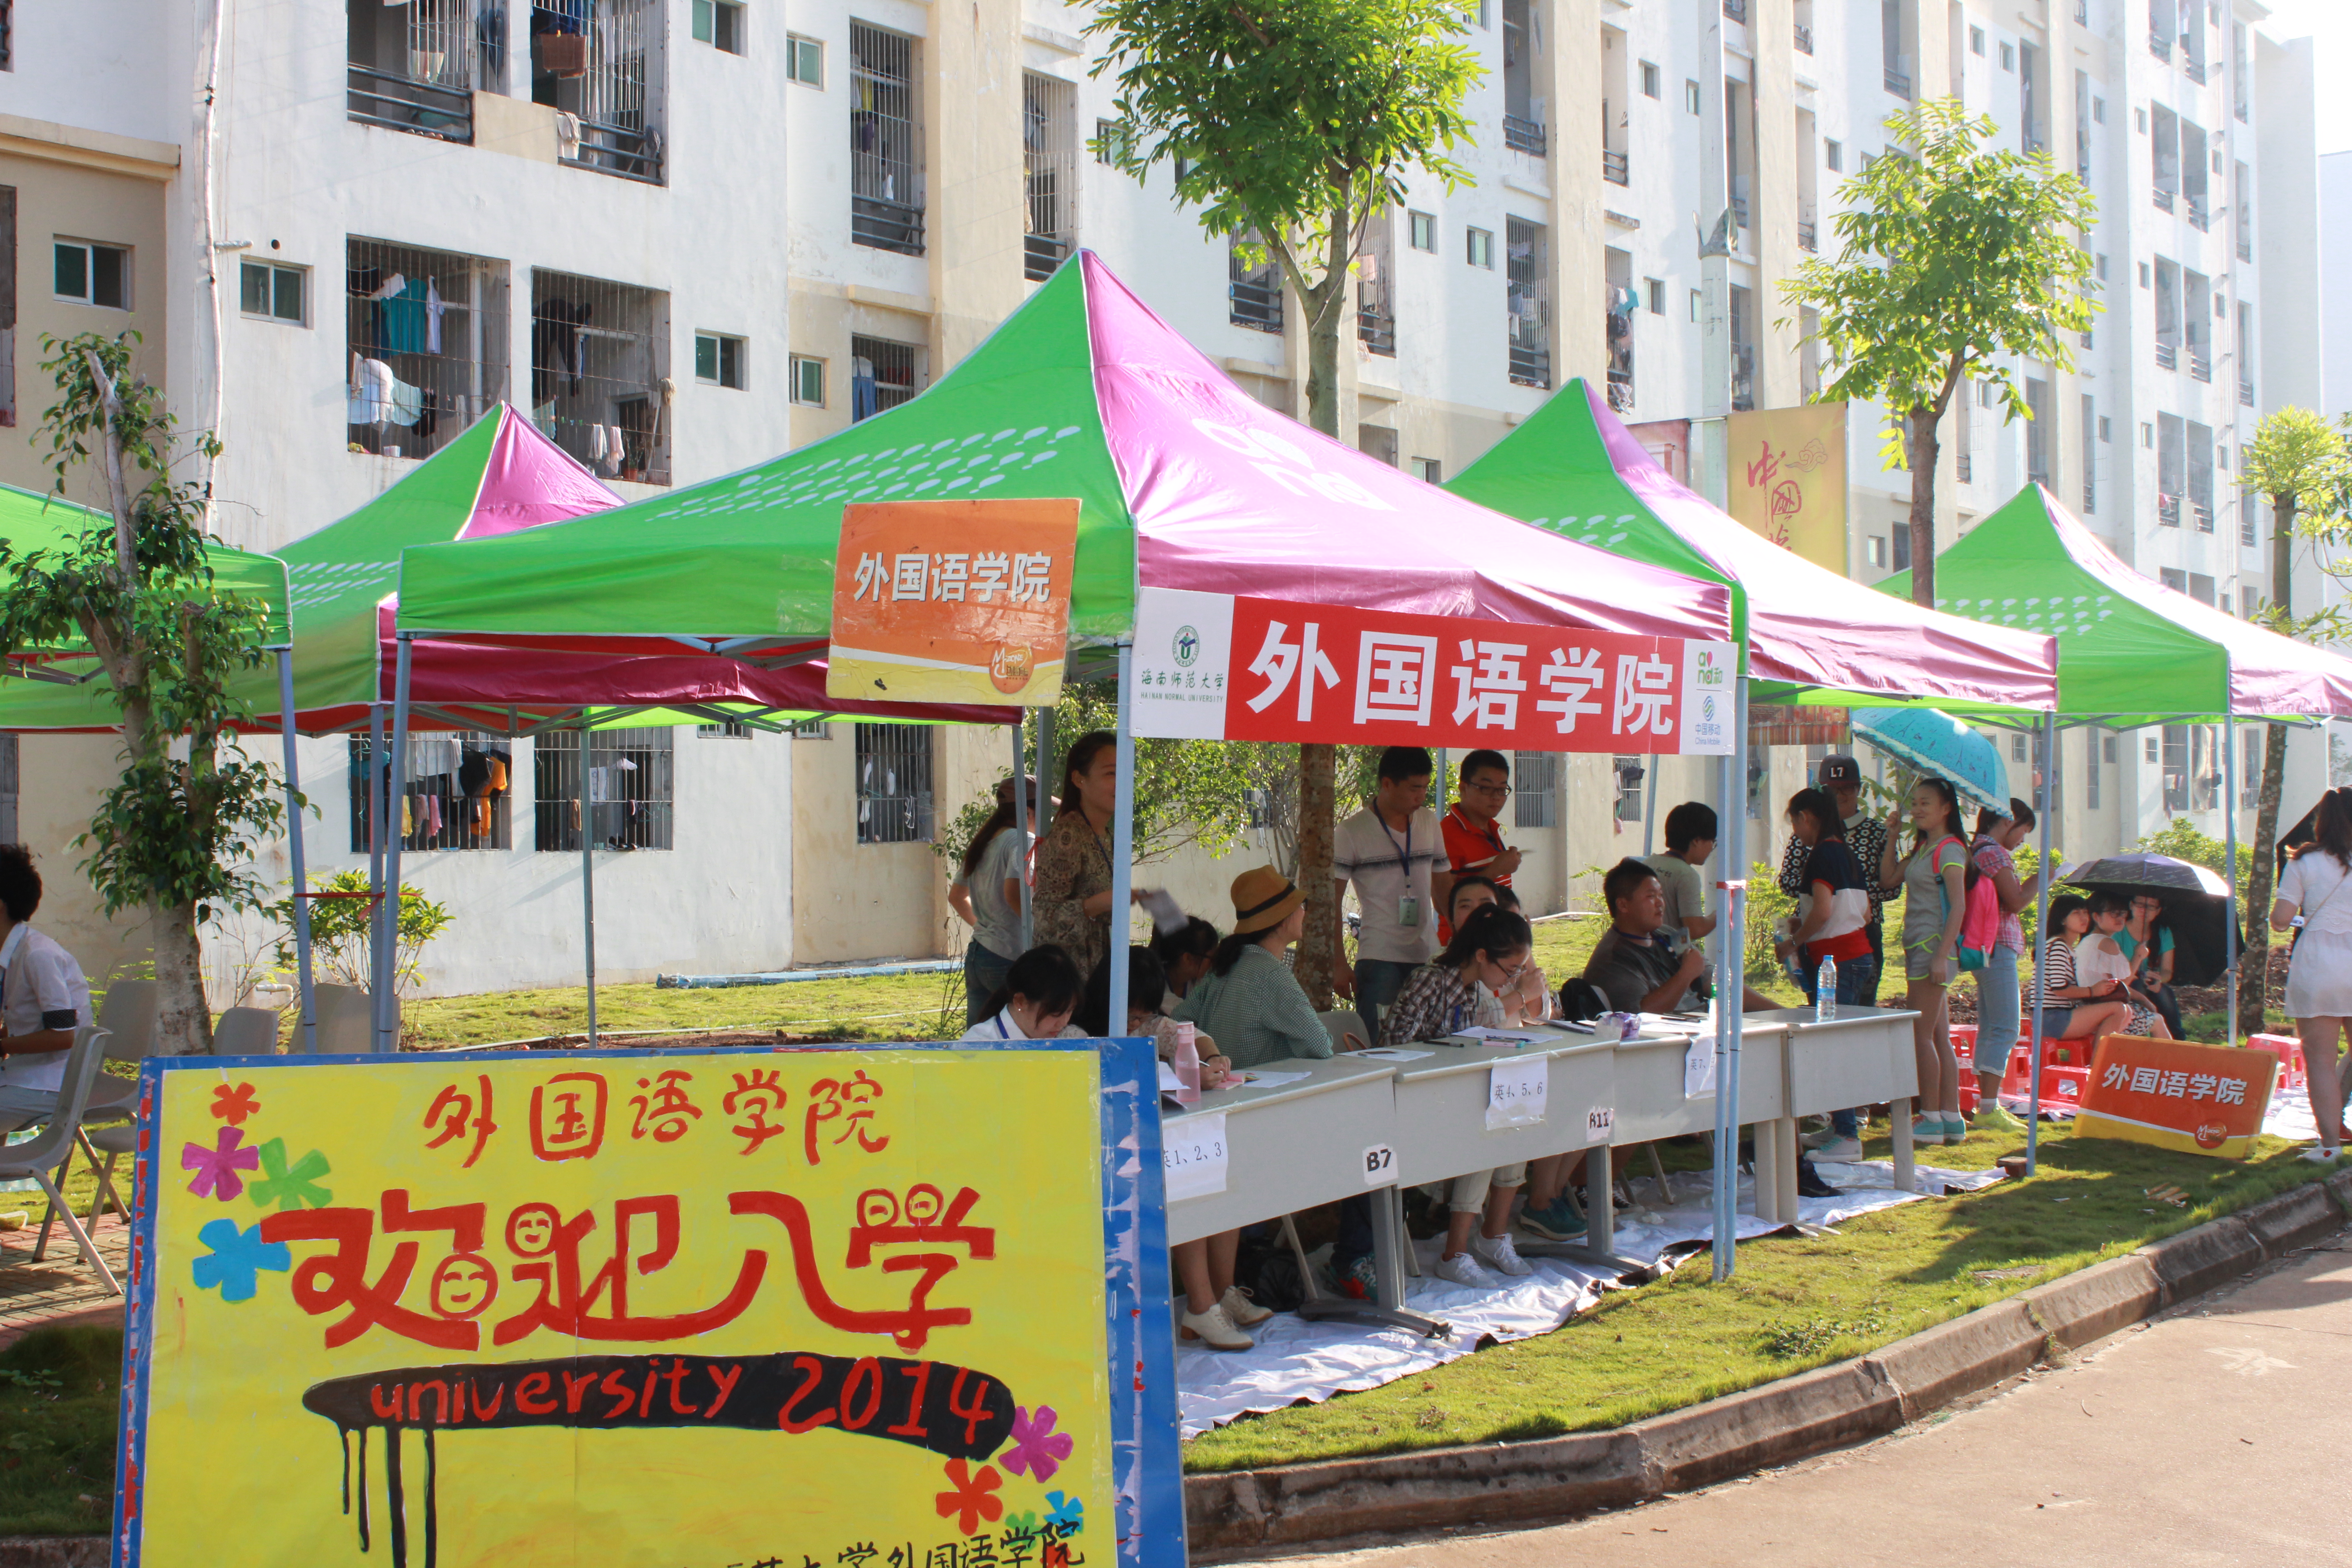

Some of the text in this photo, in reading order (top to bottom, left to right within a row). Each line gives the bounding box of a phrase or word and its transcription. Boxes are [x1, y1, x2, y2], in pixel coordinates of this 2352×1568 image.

[853, 551, 1051, 603] 外国语学院
[1142, 669, 1223, 691] 海南师范大学
[1246, 620, 1675, 735] 外国语学院
[1141, 691, 1224, 703] HAINAN NORMAL UNIVERSITY
[1695, 722, 1721, 736] 中国移动
[1695, 737, 1707, 745] China
[1830, 766, 1844, 778] L7
[2102, 1063, 2248, 1106] 外国语学院
[423, 1069, 890, 1168] 外国语学院
[1366, 1148, 1392, 1172] B7
[260, 1182, 995, 1354] 欢迎入学
[371, 1355, 994, 1444] university 2014
